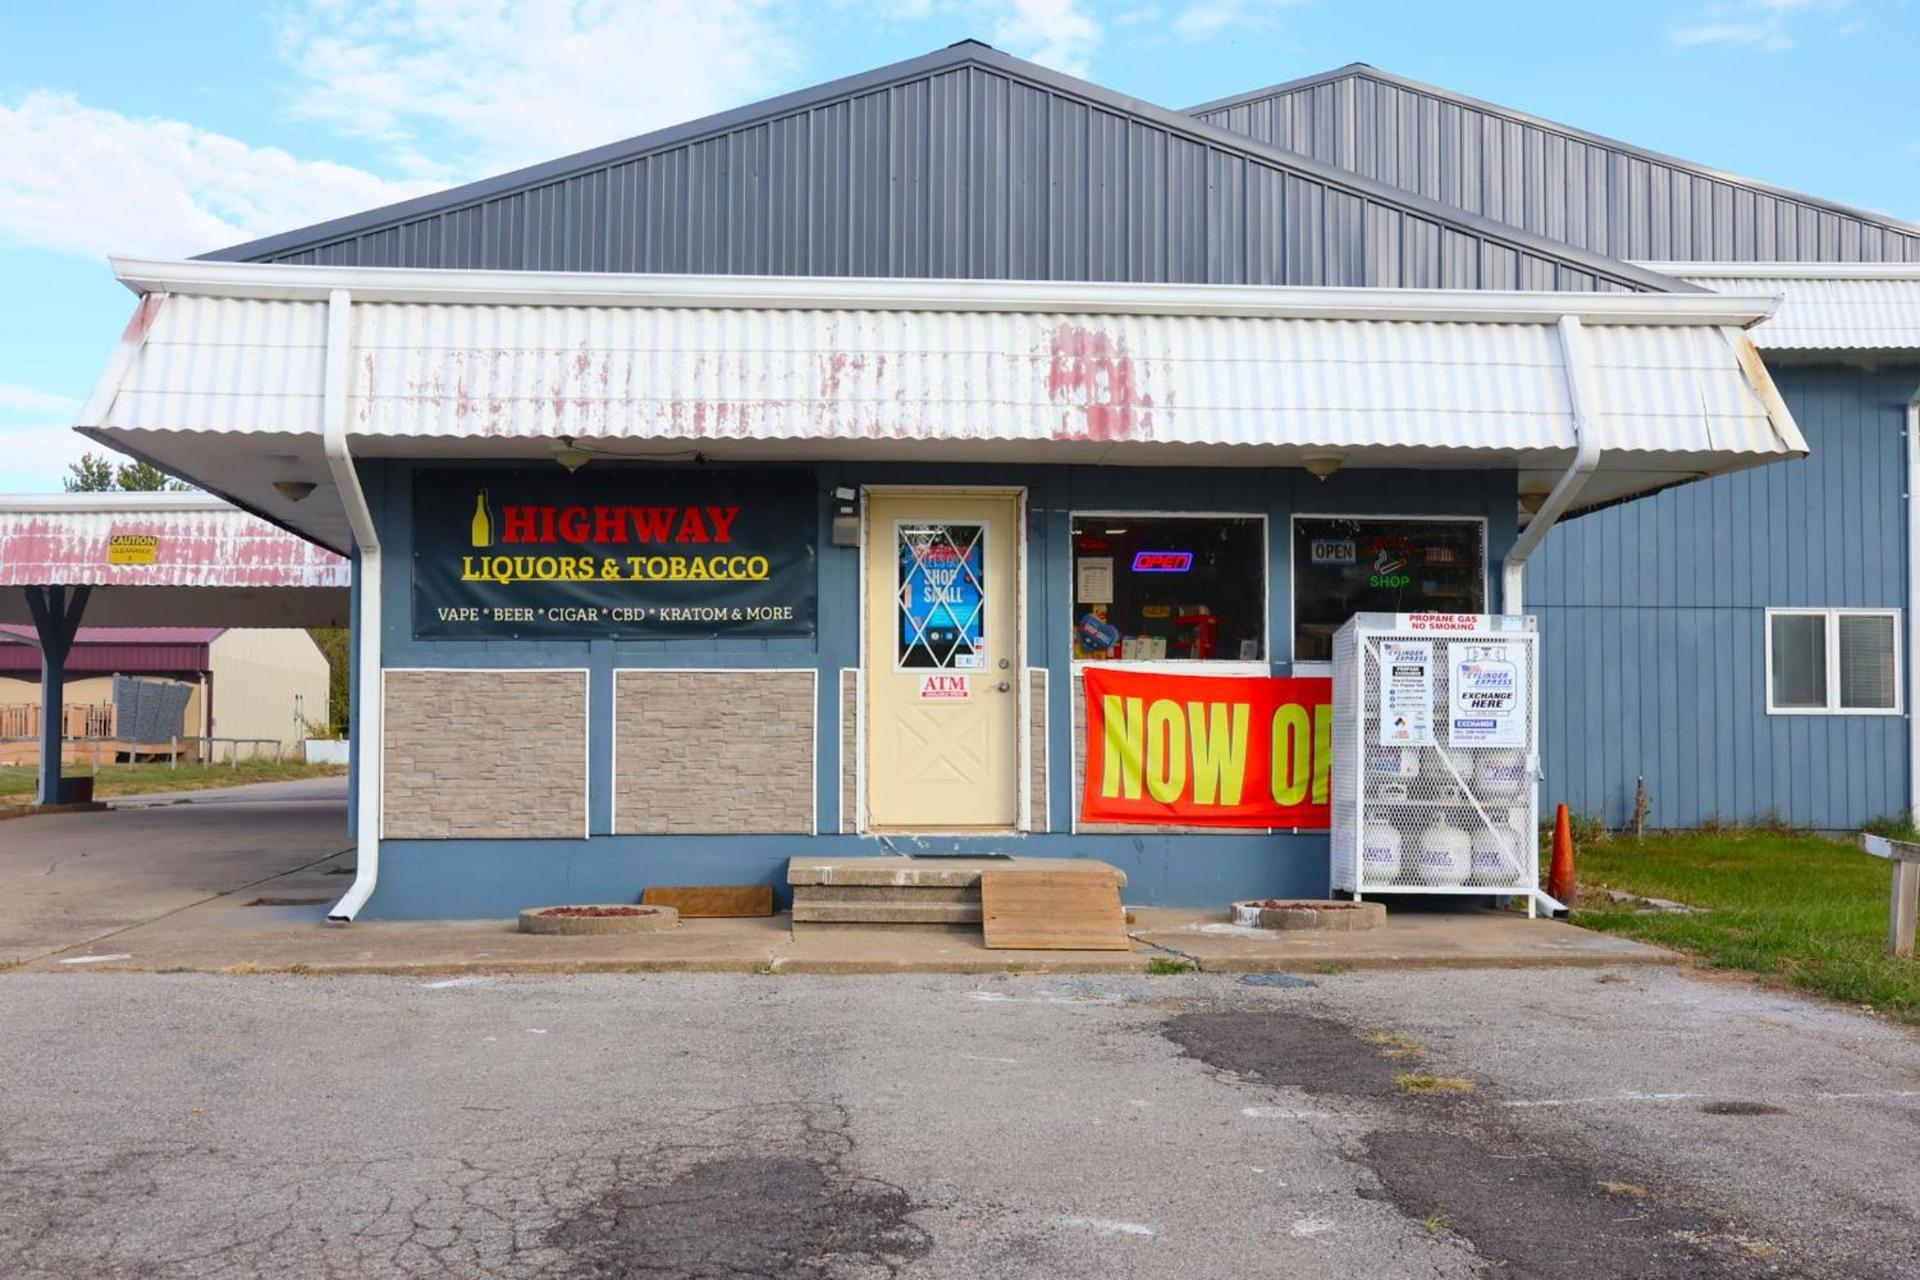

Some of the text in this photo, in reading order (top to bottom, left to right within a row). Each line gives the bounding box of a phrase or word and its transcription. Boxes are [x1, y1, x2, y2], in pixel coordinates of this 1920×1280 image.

[502, 506, 741, 543] HIGHWAY
[111, 536, 156, 545] CAUTION
[1315, 544, 1353, 559] OPEN
[462, 556, 769, 584] LIQUORS & TOBACCO
[924, 569, 956, 585] SHOP
[1370, 576, 1410, 587] SHOP
[924, 587, 963, 603] SMALL
[438, 605, 794, 622] VAPE BEER CIGAR CBD KRATOM & MORE
[1429, 623, 1475, 631] SMOKING
[925, 676, 964, 690] ATM
[1462, 692, 1513, 700] EXCHANGE
[1471, 700, 1504, 708] HERE
[1102, 694, 1249, 806] NOW
